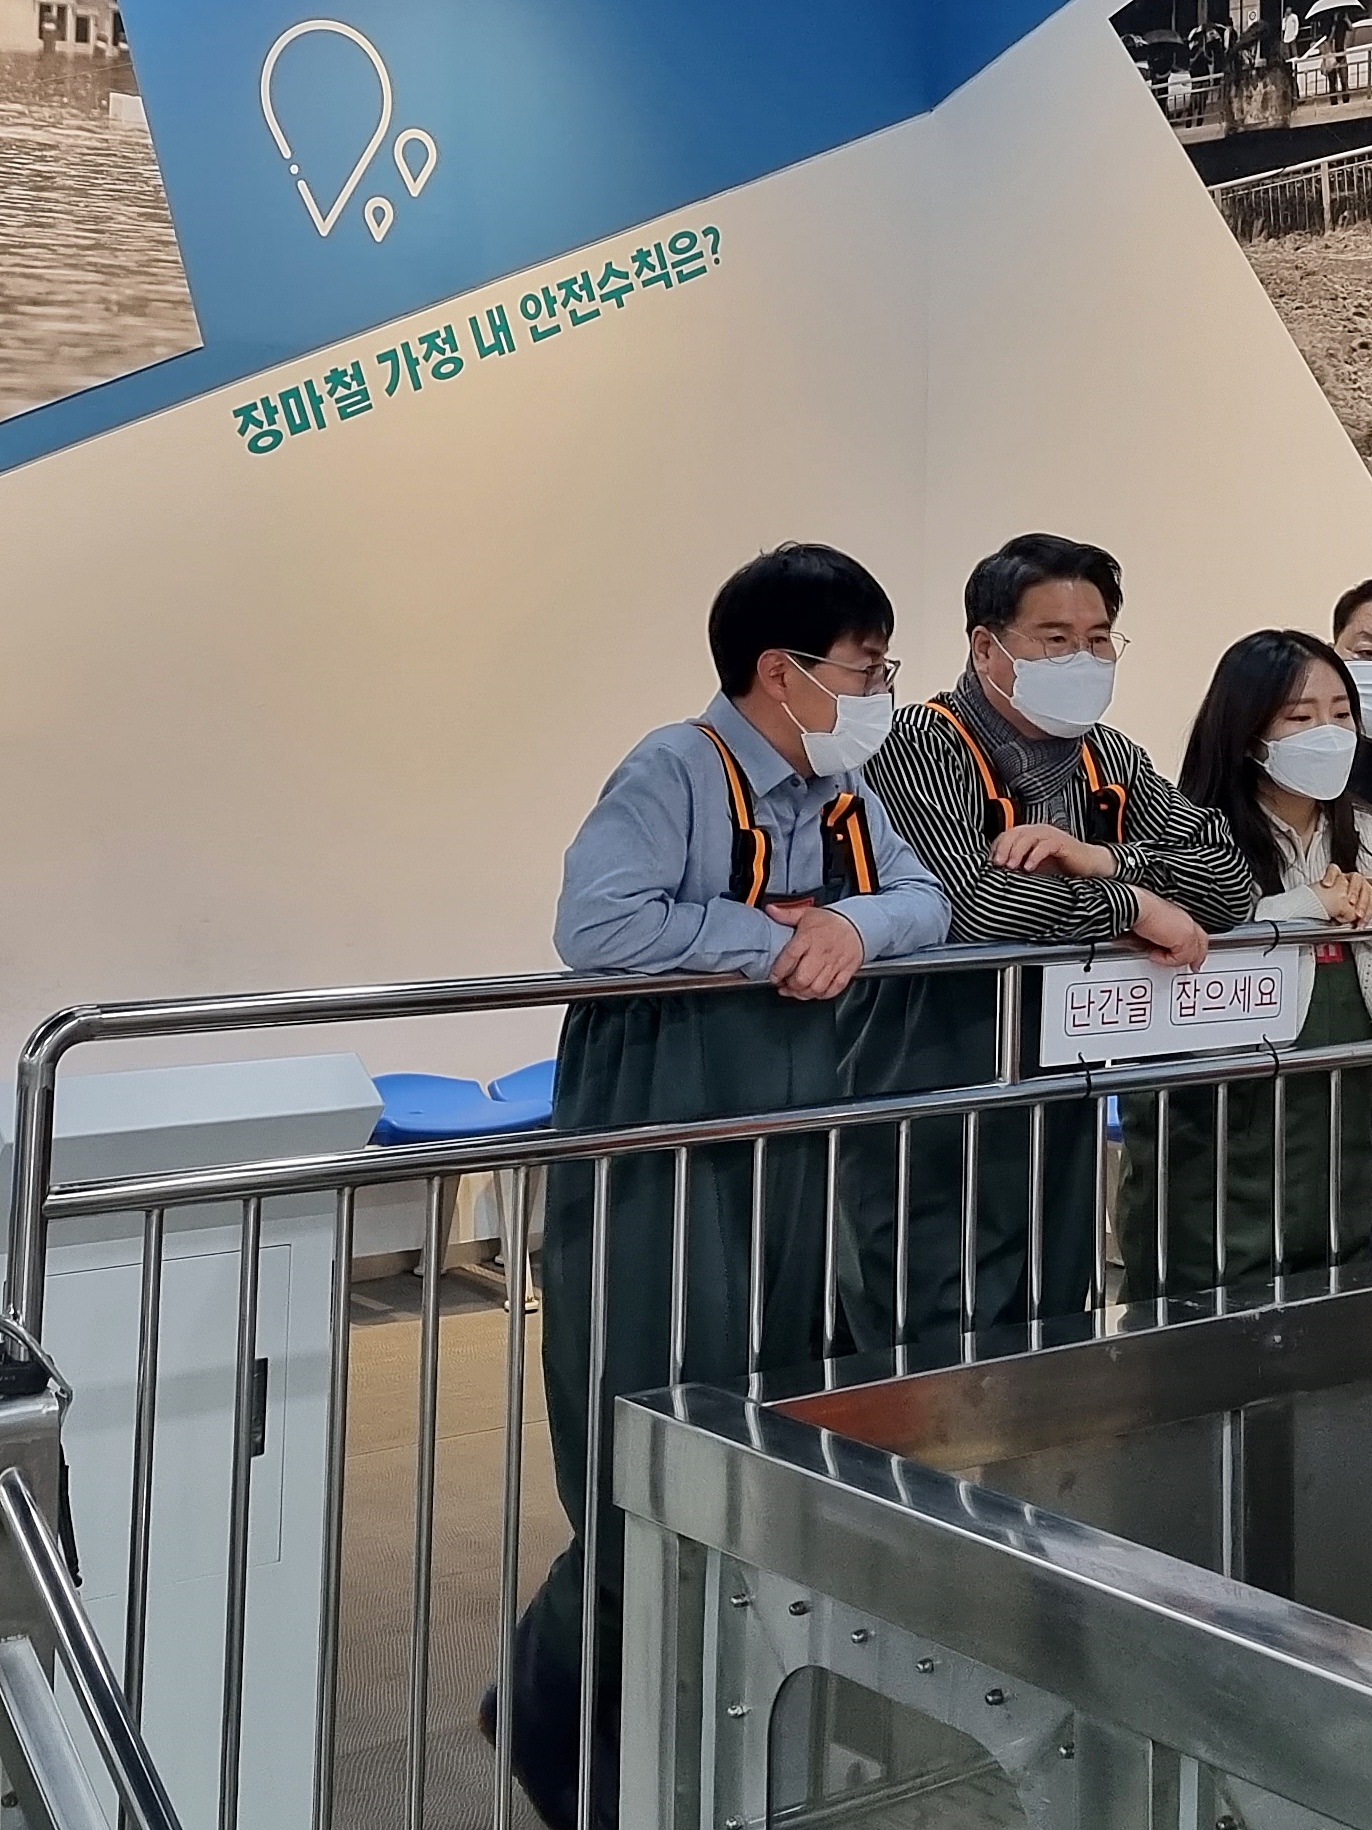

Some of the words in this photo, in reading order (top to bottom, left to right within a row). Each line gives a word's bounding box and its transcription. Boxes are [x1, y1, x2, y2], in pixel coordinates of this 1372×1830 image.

[232, 360, 374, 455] 장마철
[376, 324, 465, 398] 가정
[468, 304, 517, 358] 내
[519, 225, 722, 344] 안전수칙은?
[1070, 984, 1152, 1029] 난간을
[1176, 975, 1278, 1018] 잡으세요
